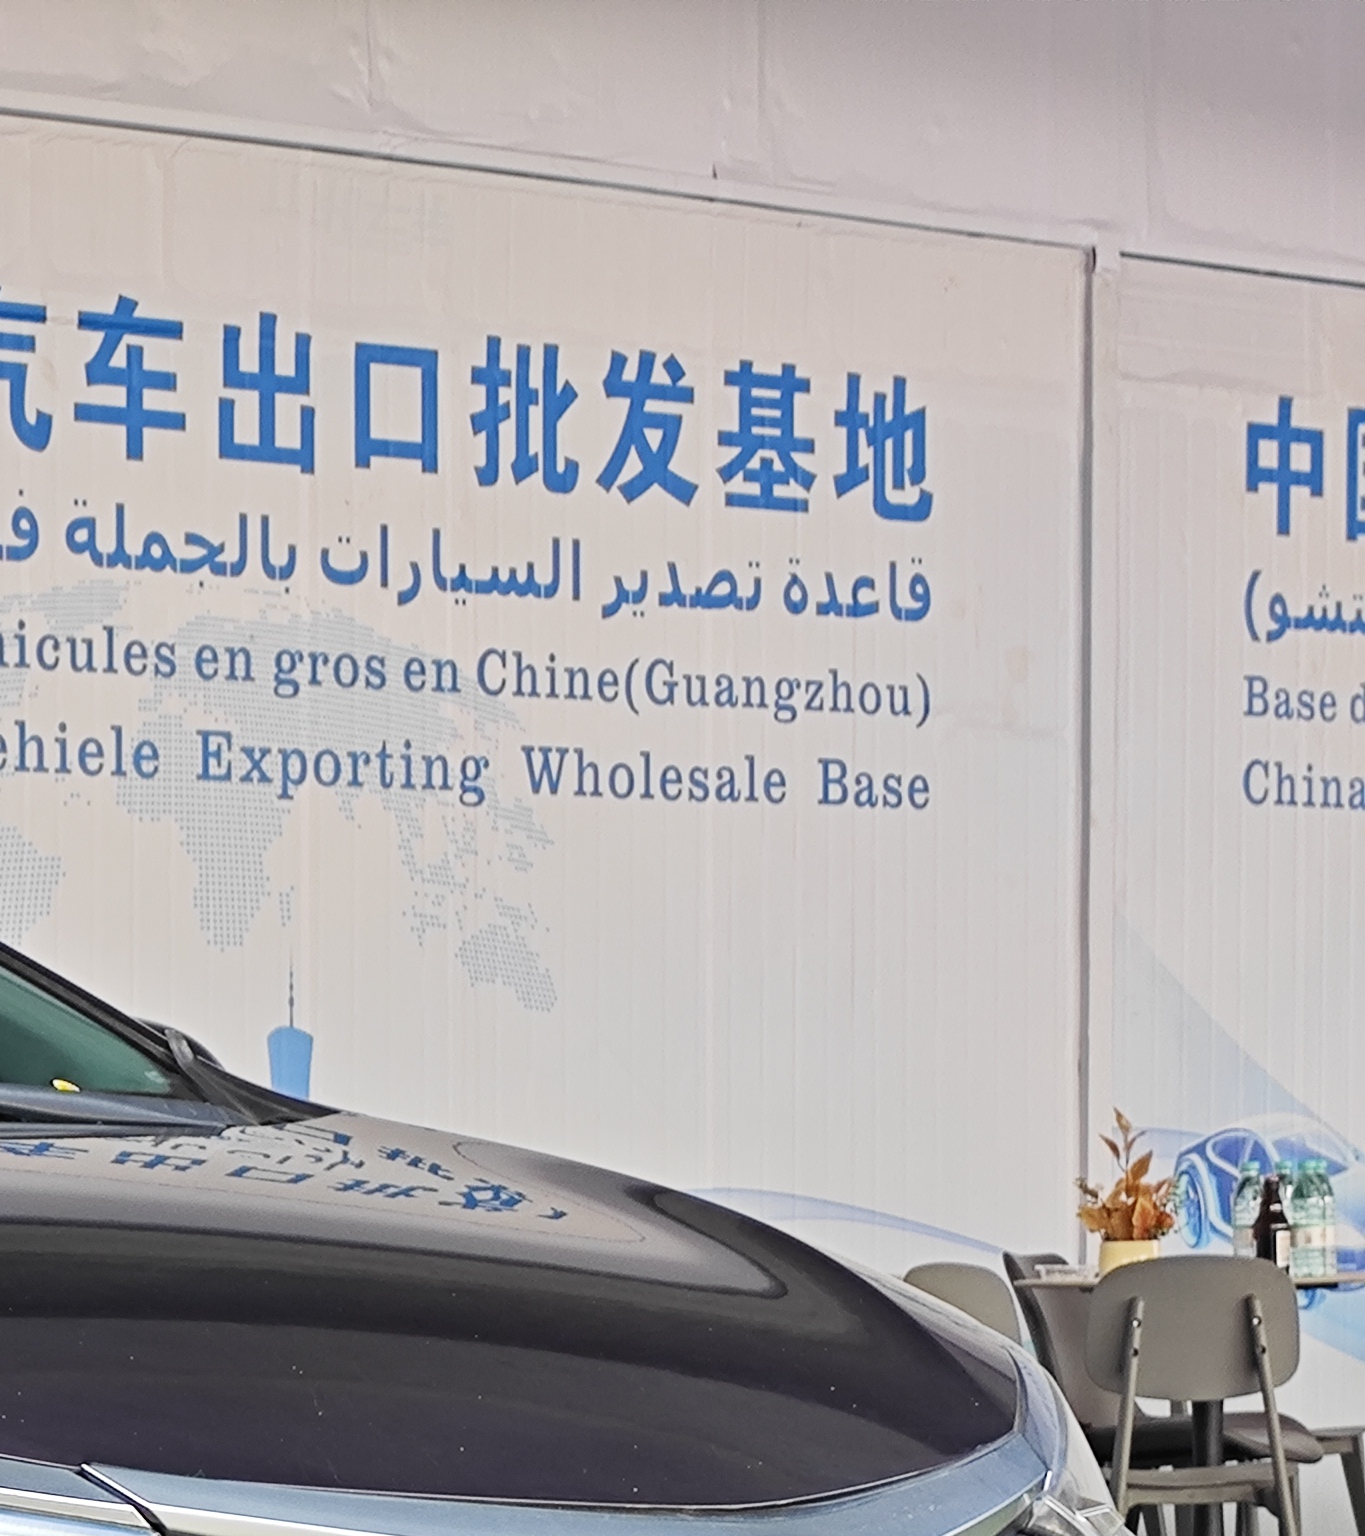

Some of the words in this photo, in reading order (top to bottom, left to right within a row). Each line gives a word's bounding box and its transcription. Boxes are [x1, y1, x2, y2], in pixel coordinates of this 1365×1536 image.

[1246, 396, 1365, 541] 中
[65, 498, 298, 594] بالجملة
[320, 524, 581, 606] السيارات
[601, 559, 762, 619] تصدير
[783, 557, 932, 622] قاعدة
[194, 645, 256, 682] en
[273, 649, 388, 698] gros
[403, 655, 462, 695] en
[475, 647, 931, 728] Chine(Guangzhou)
[1243, 674, 1337, 722] Base
[195, 729, 490, 807] Exporting
[521, 744, 787, 804] Wholesale
[817, 756, 931, 809] Base
[1242, 758, 1365, 811] China
